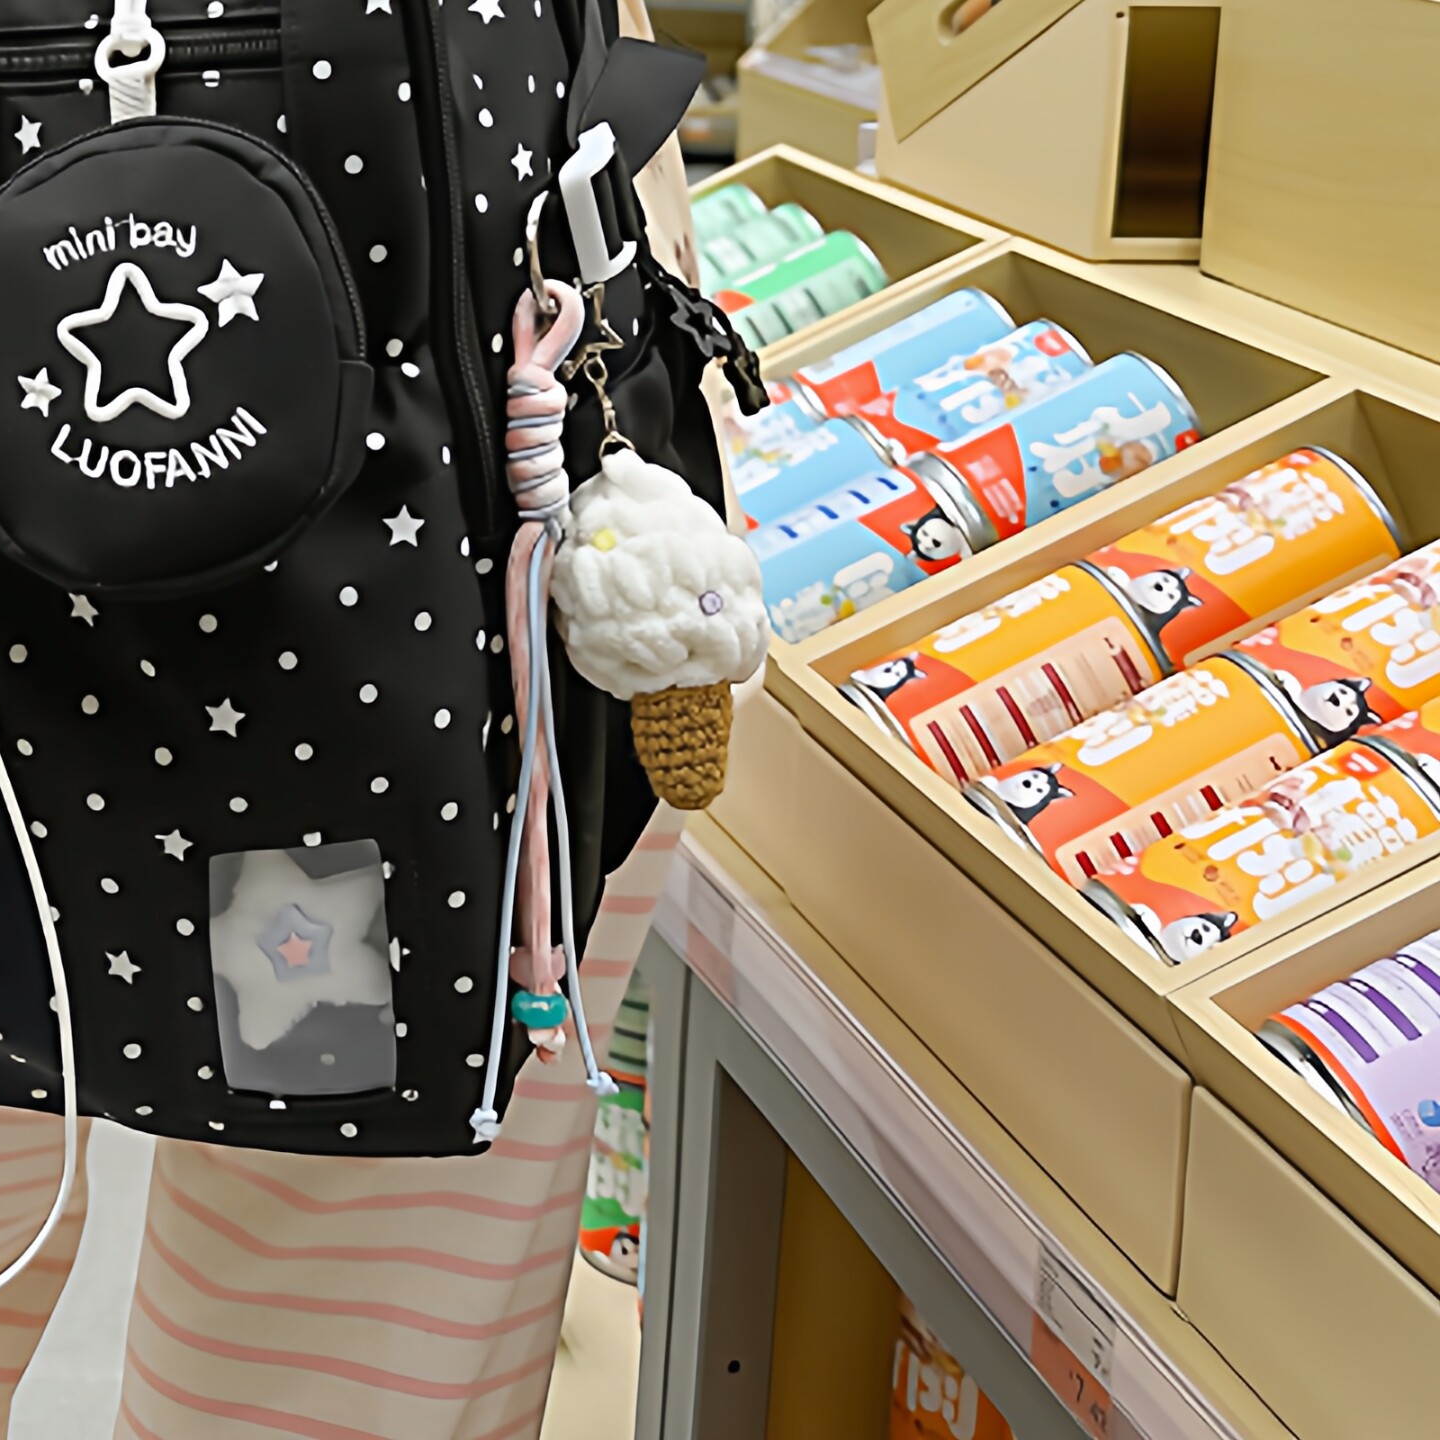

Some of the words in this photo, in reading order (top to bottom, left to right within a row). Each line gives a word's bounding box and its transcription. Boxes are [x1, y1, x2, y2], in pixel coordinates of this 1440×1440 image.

[43, 216, 116, 271] mini
[128, 212, 197, 258] bay
[50, 406, 268, 490] LUOFANNI
